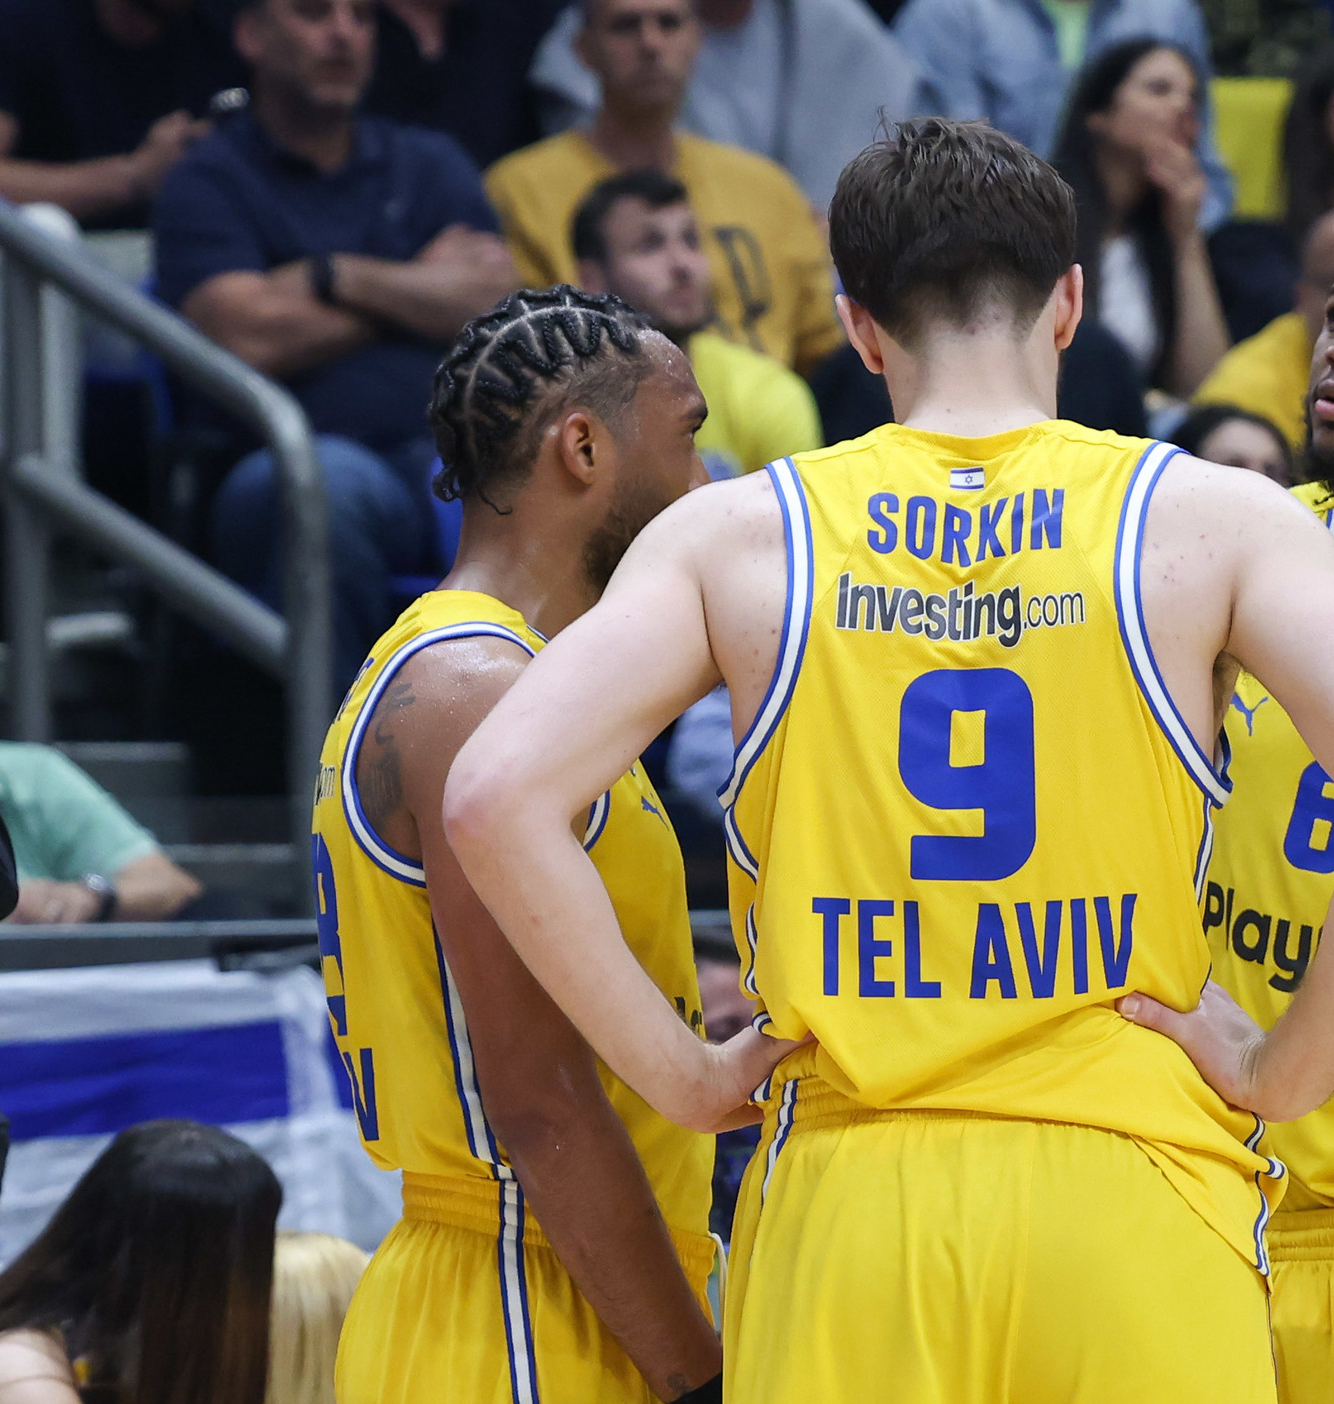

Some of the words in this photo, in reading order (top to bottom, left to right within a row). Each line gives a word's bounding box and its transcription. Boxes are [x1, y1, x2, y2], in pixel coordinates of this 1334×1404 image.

[867, 488, 1065, 568] SORKIN
[834, 570, 1086, 647] Investing.com
[898, 667, 1037, 881] 9
[811, 896, 941, 999] TEL
[969, 893, 1138, 1000] AVIV
